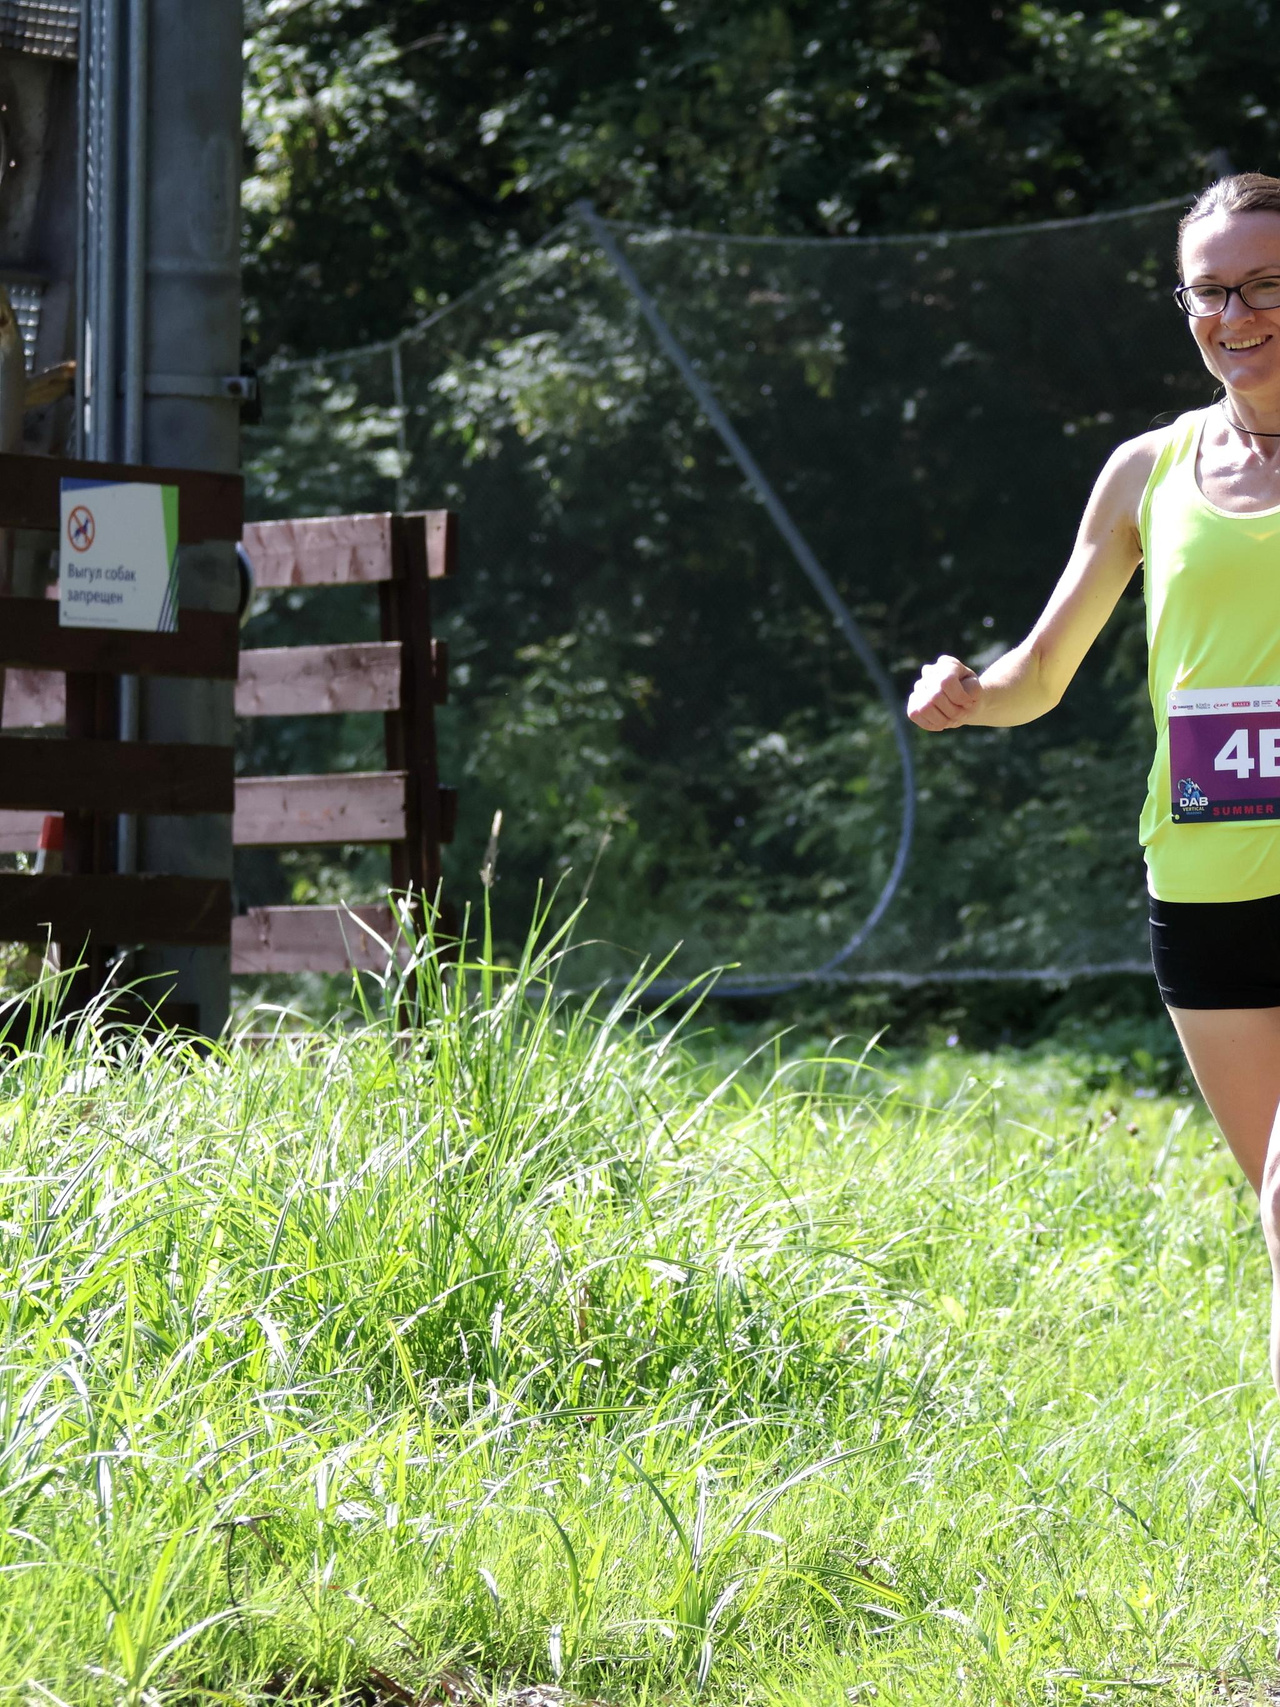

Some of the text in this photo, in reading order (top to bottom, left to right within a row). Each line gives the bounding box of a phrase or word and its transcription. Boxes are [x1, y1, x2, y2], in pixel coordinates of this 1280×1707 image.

[67, 563, 137, 584] Выгул собак
[67, 589, 124, 606] запрещен
[1179, 797, 1209, 807] DAB
[1212, 803, 1274, 817] SUMMER
